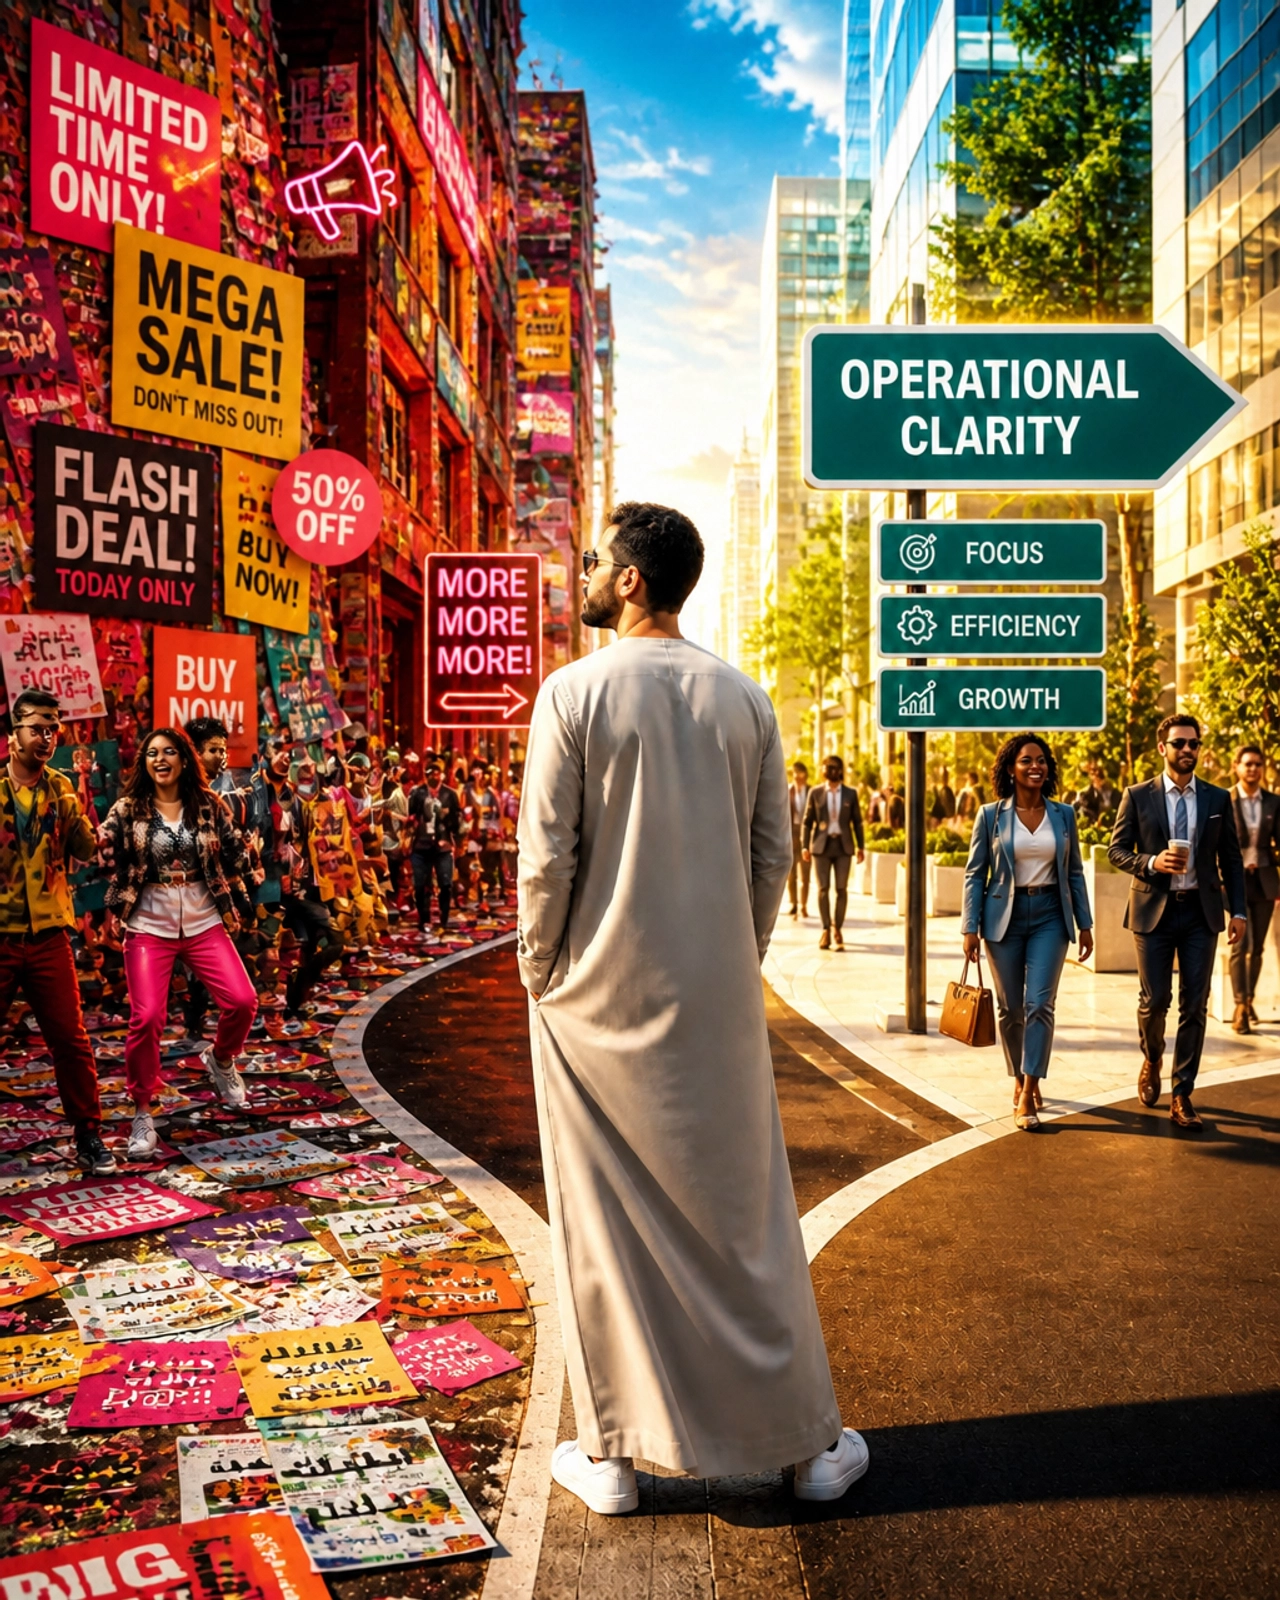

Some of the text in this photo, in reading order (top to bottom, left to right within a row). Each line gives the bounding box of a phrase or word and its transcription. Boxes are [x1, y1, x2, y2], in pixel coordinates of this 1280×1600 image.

[51, 51, 208, 153] LIMITED
[50, 105, 149, 183] TIME
[50, 161, 165, 235] ONLY!
[138, 250, 283, 343] MEGA
[136, 316, 282, 404] SALE!
[840, 358, 1139, 400] OPERATIONAL
[134, 386, 283, 438] DON'T MISS OUT!
[901, 415, 1081, 456] CLARITY
[55, 446, 198, 517] FLASH
[291, 471, 365, 513] 50%
[56, 504, 196, 573] DEAL!
[296, 510, 356, 546] OFF
[237, 529, 290, 569] BUY
[966, 541, 1044, 564] FOCUS
[56, 568, 195, 607] TODAY ONLY
[235, 563, 299, 608] NOW!
[437, 568, 528, 598] MORE
[437, 606, 528, 636] MORE
[950, 615, 1081, 637] EFFICIENCY
[176, 654, 237, 693] BUY
[437, 645, 532, 675] MORE!
[958, 688, 1060, 710] GROWTH
